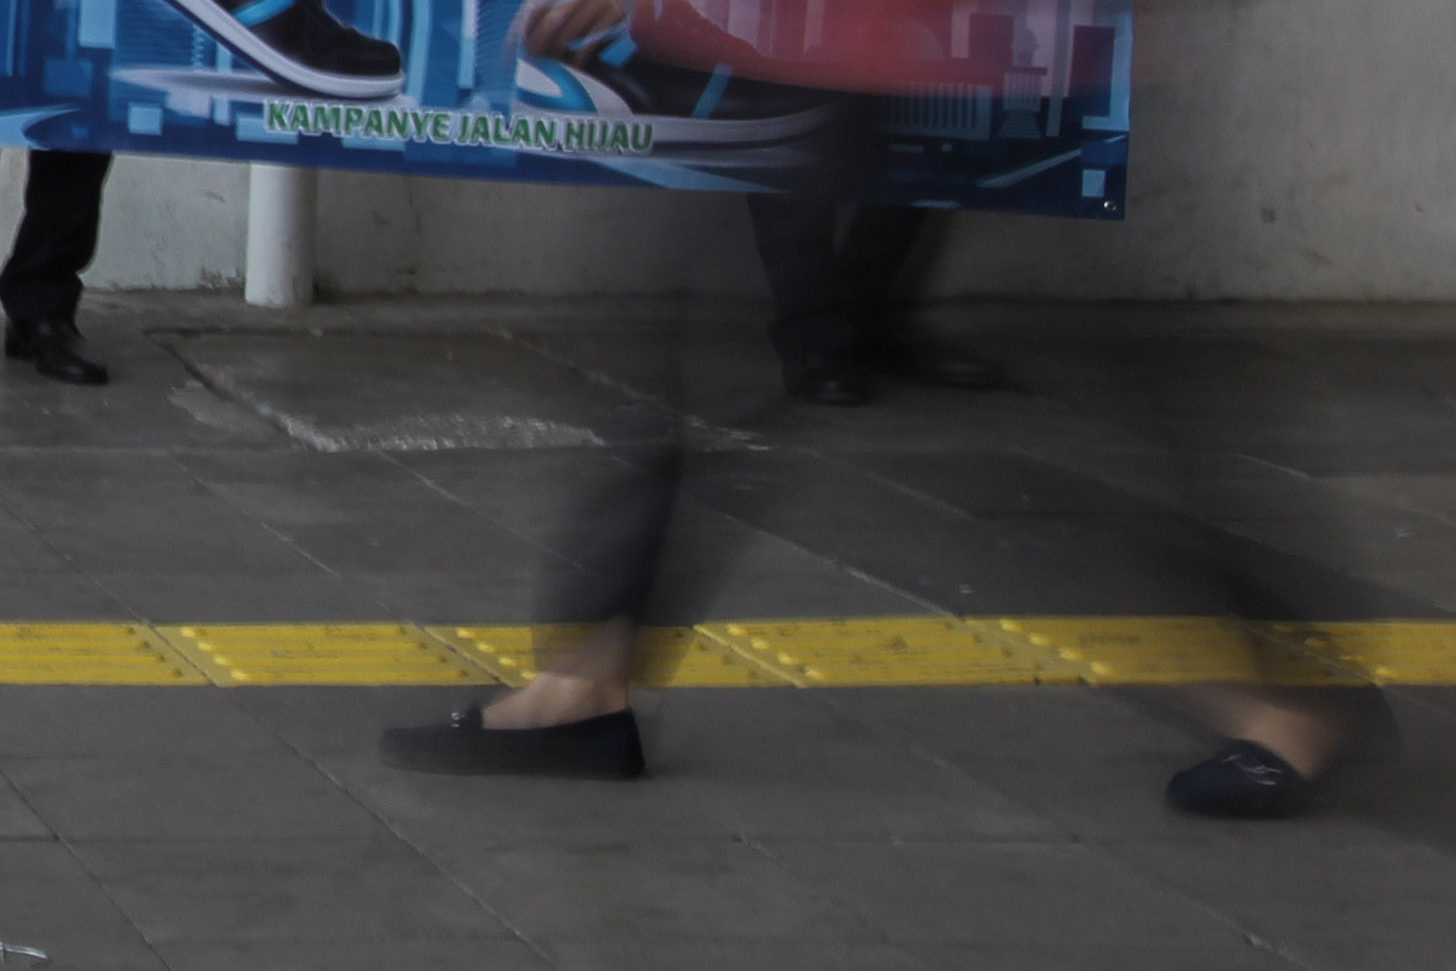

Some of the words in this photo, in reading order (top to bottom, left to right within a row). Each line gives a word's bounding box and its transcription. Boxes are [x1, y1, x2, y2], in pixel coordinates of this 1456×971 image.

[266, 101, 451, 143] KAMPANYE
[457, 113, 558, 150] JALAN
[562, 121, 655, 152] HIJAU
